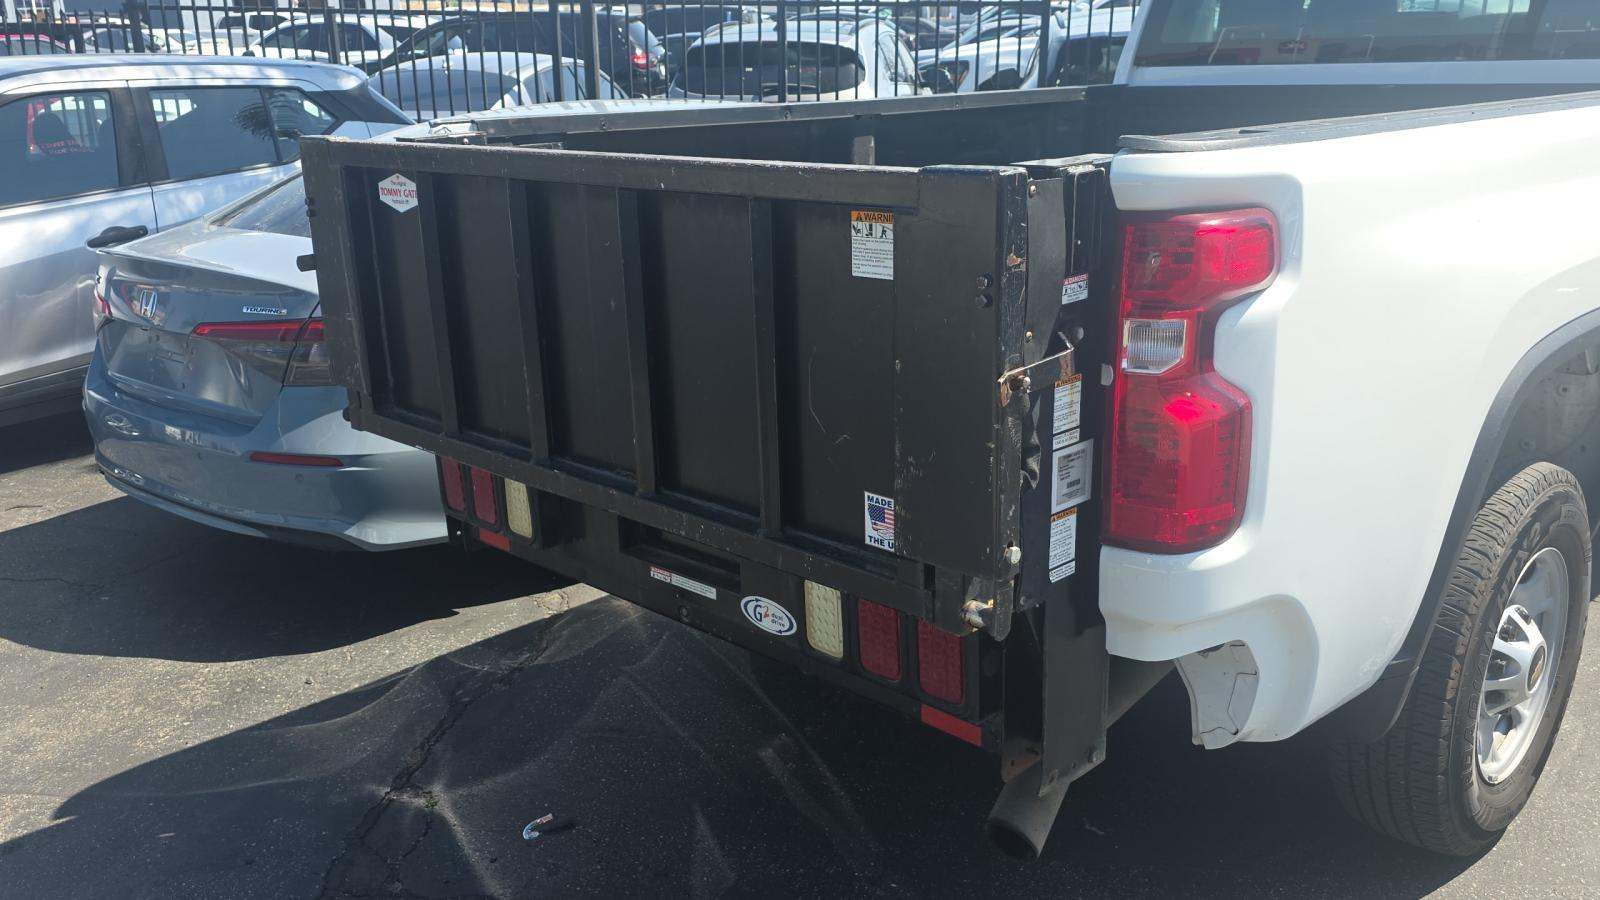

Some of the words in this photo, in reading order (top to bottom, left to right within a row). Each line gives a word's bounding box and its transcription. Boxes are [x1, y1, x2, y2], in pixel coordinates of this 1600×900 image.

[380, 186, 401, 197] TOMMY
[864, 211, 894, 223] WARNI
[243, 305, 288, 316] TOURING
[867, 494, 893, 508] MADE
[868, 534, 885, 547] THE
